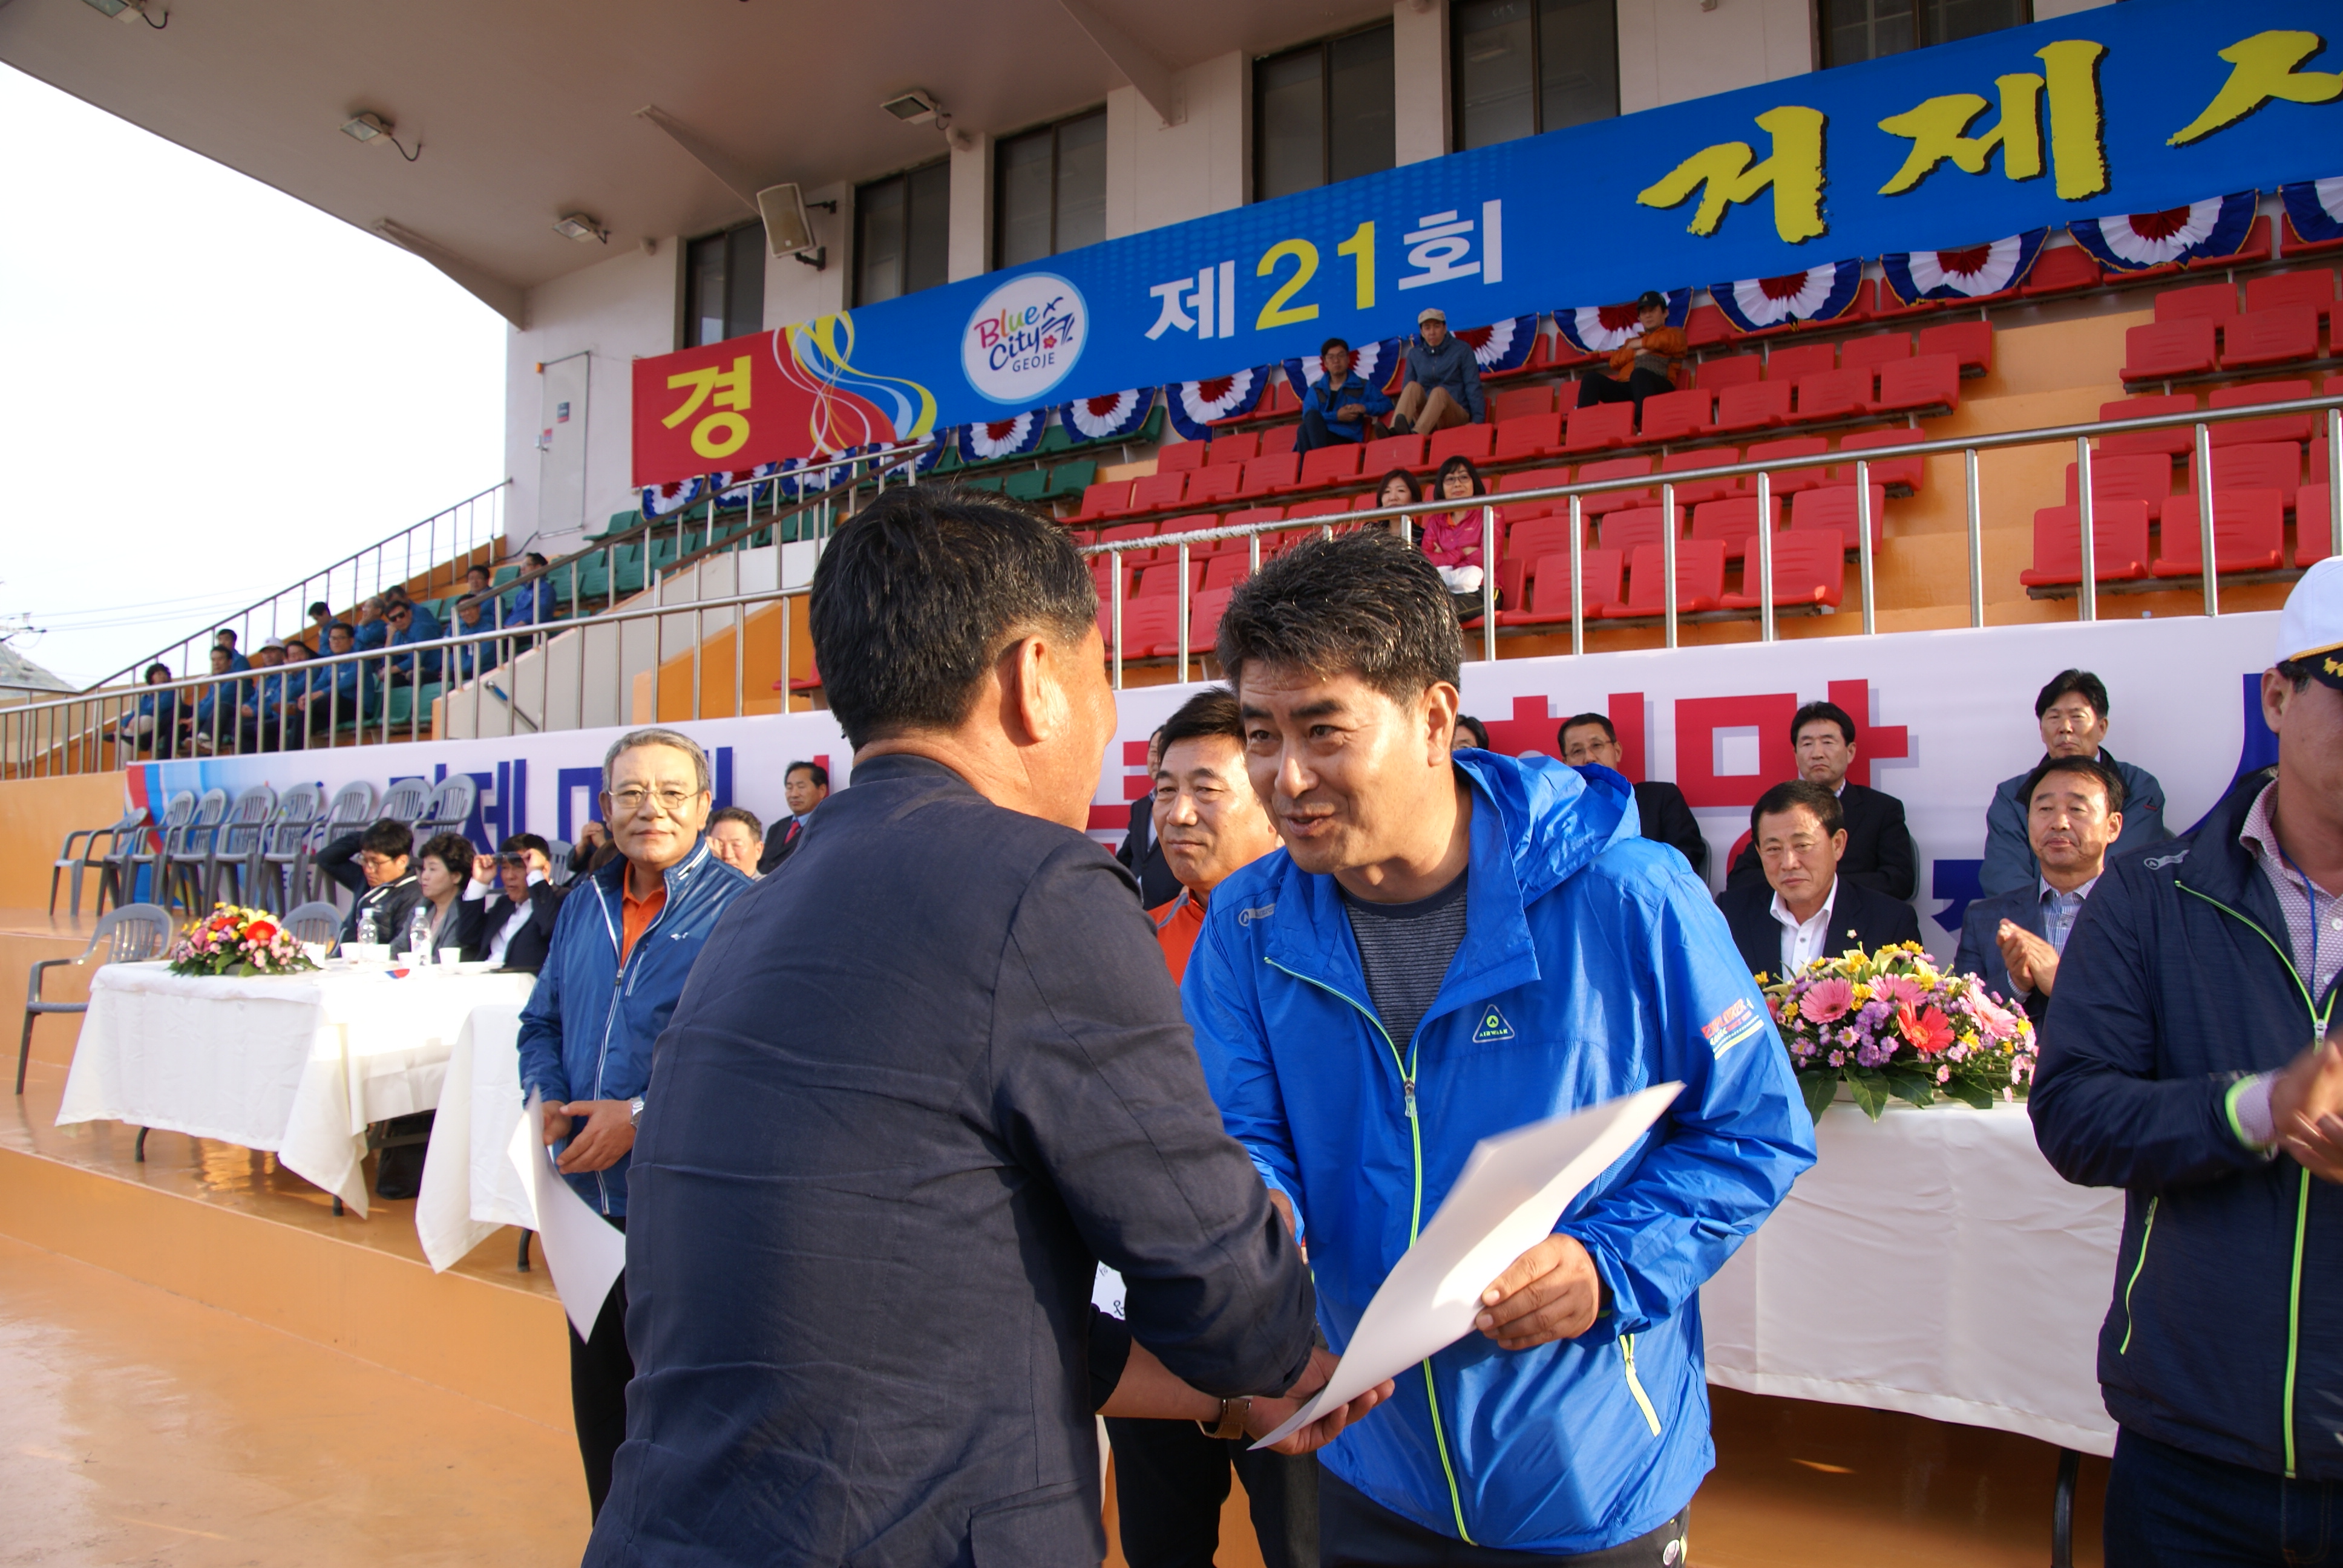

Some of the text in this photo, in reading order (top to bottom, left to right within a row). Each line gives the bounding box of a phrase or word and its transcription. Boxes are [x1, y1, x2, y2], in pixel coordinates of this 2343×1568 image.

[974, 305, 1040, 349] Blue
[989, 326, 1040, 371] City
[1012, 351, 1055, 373] GEOJE
[661, 355, 752, 459] 경
